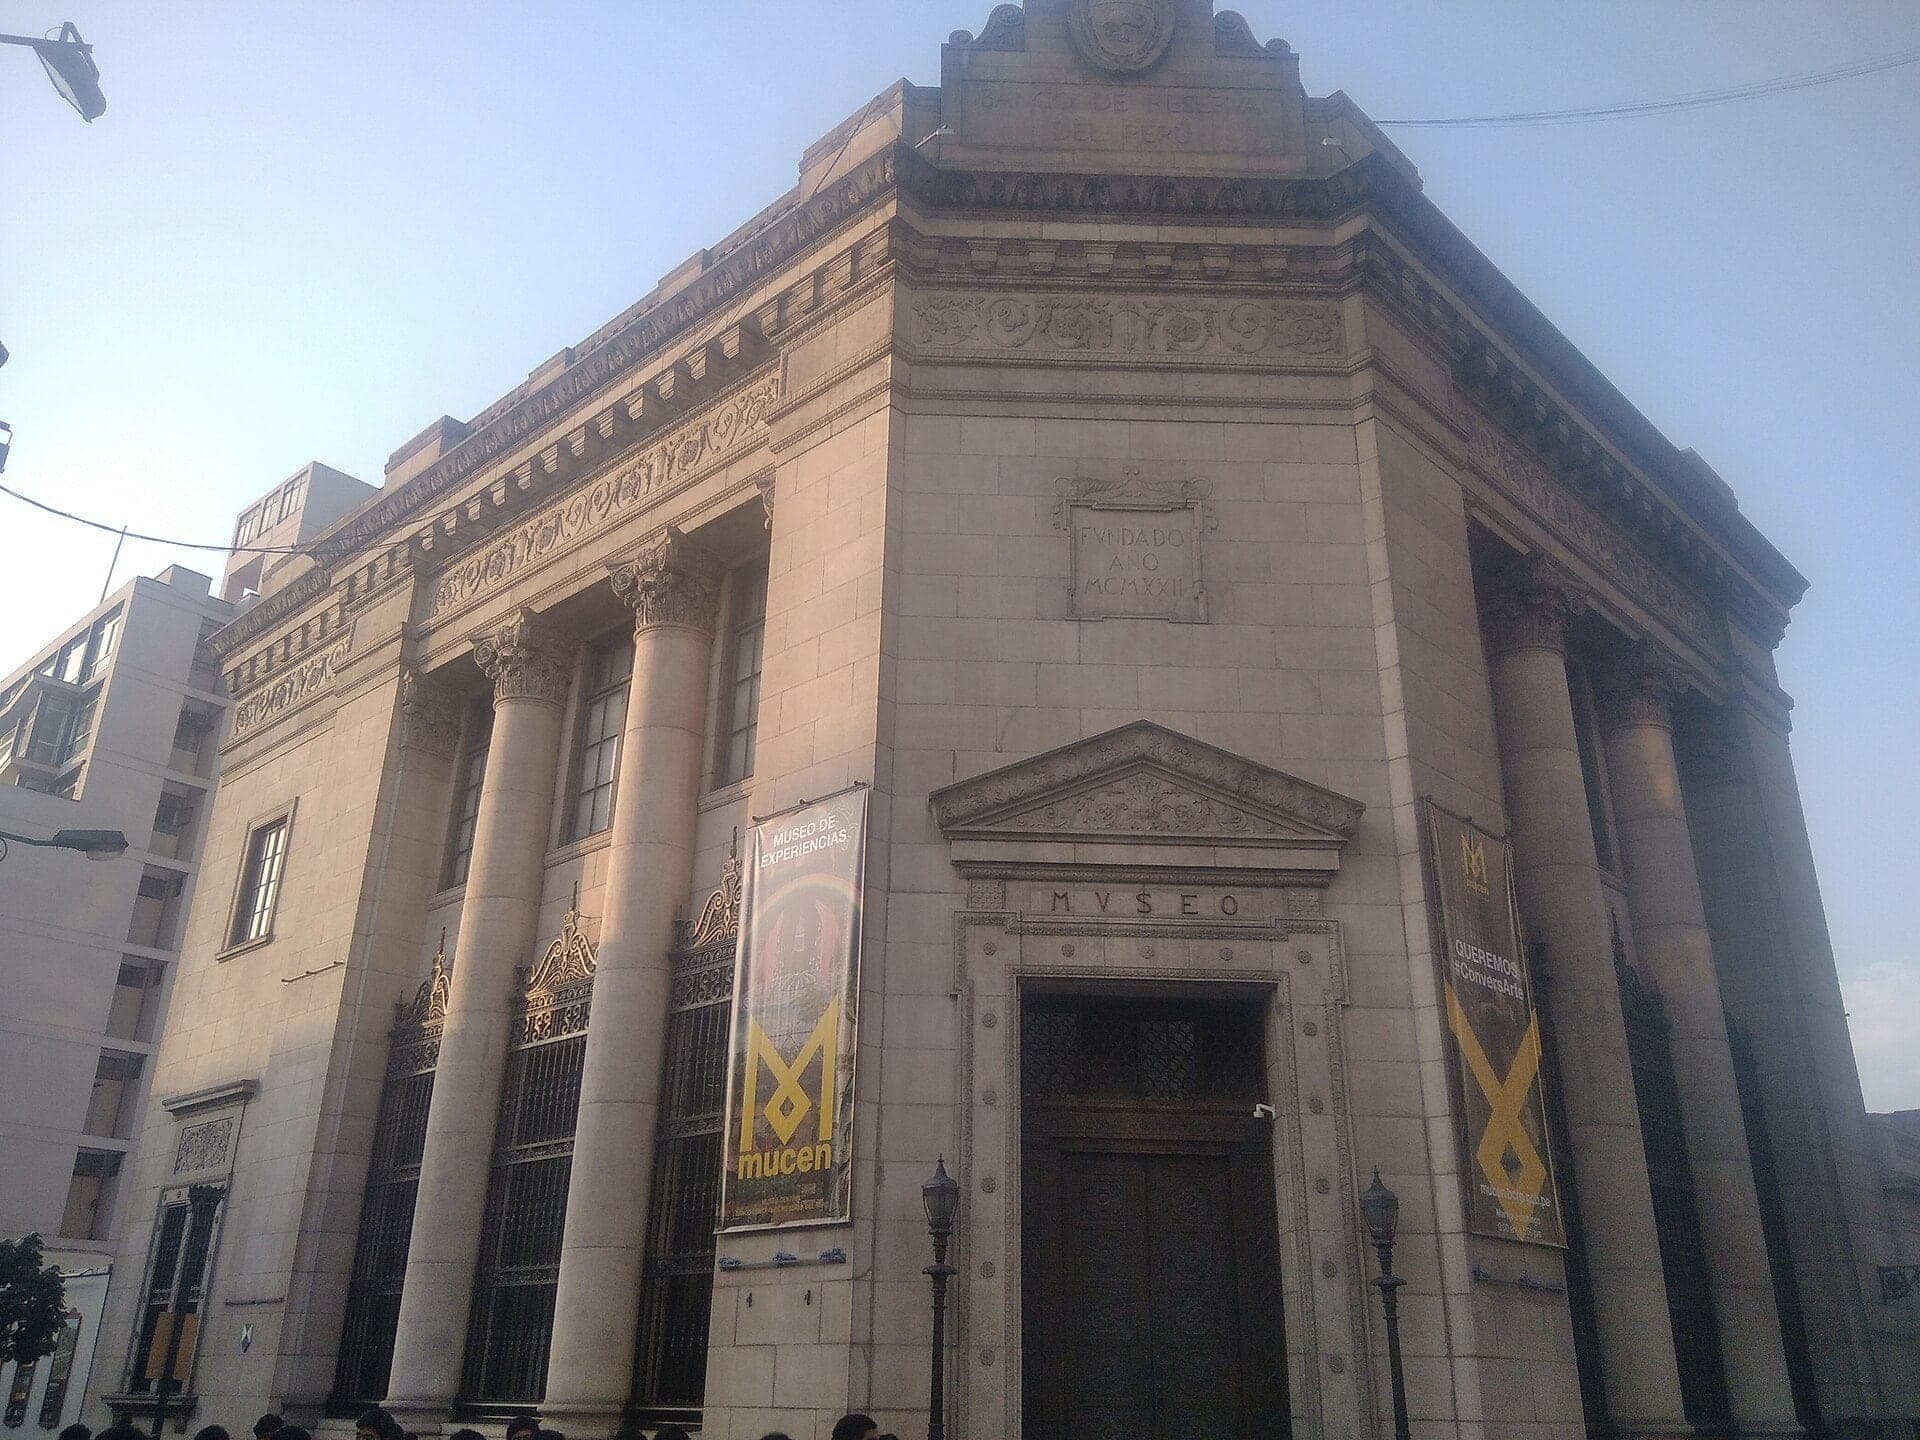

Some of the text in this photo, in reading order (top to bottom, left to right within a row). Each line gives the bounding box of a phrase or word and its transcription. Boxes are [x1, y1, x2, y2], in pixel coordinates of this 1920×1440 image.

[981, 89, 1075, 111] BANCO
[1093, 93, 1128, 113] DE
[1053, 121, 1108, 143] DEL
[1081, 527, 1184, 547] FVNDADO
[1084, 577, 1183, 597] MCMXXII
[773, 815, 837, 848] MUSEO DE
[760, 828, 847, 868] EXPERIENCIAS
[1052, 892, 1238, 915] MVSEO
[1455, 939, 1521, 980] QUEREMOS
[1453, 960, 1525, 1001] #ConversArte
[737, 1143, 833, 1180] mucen
